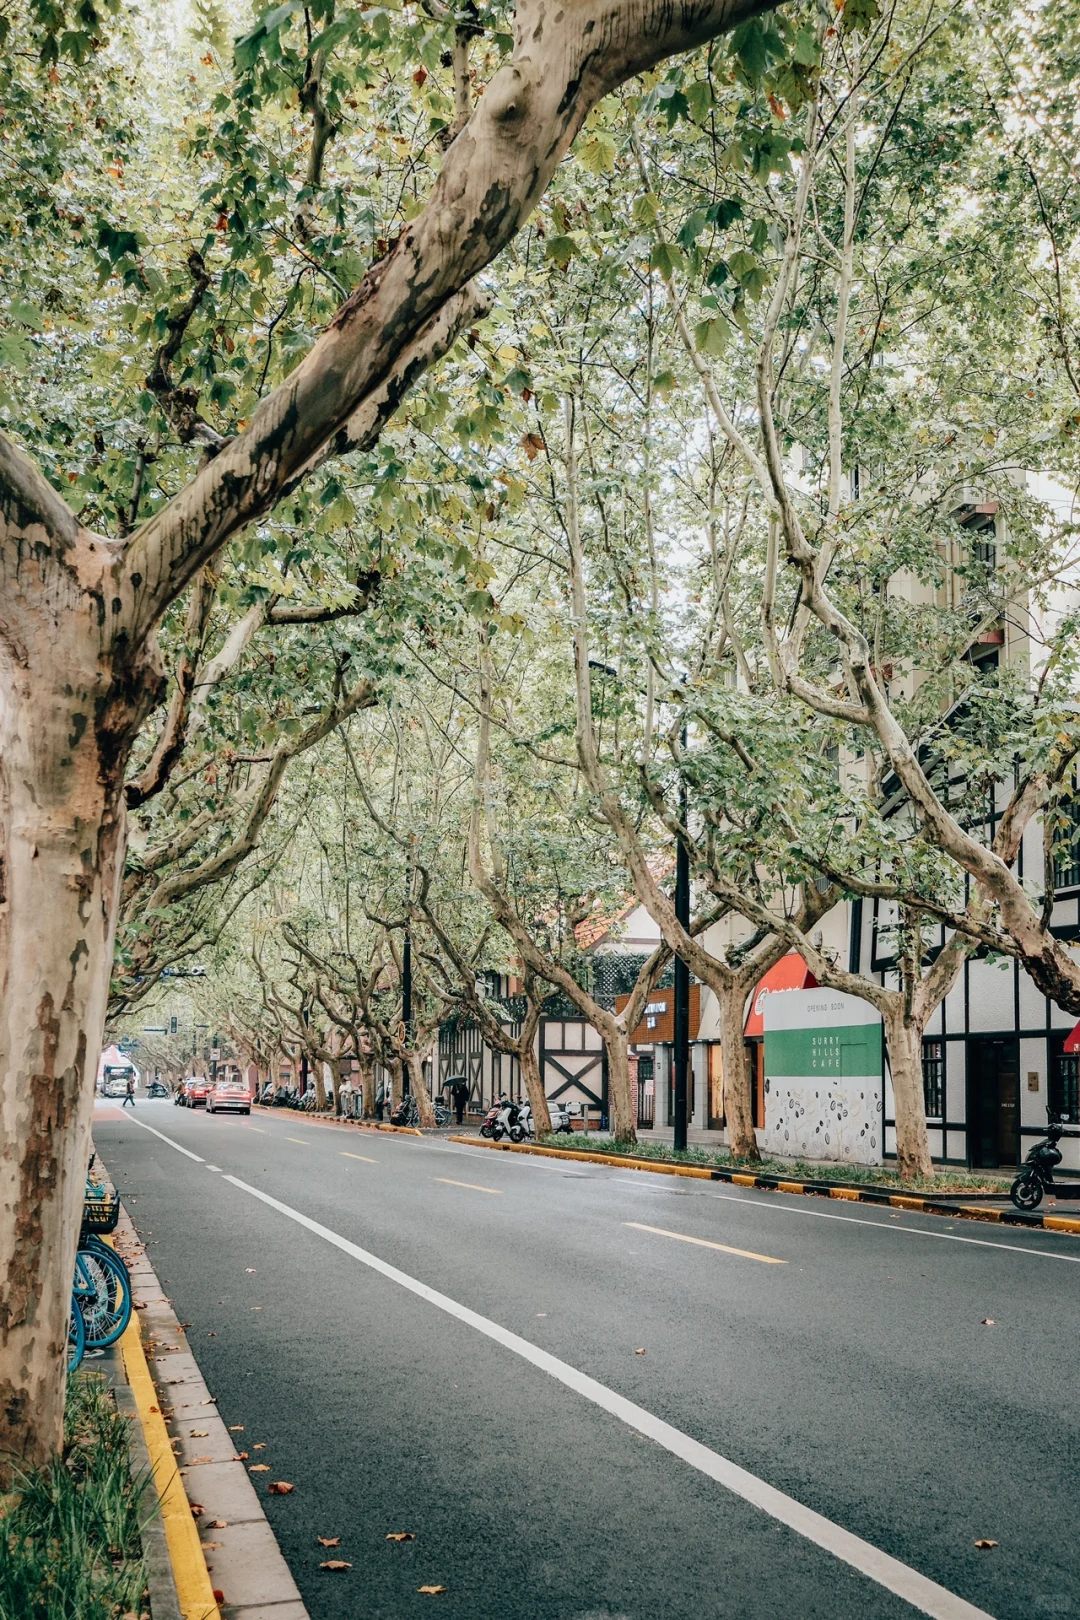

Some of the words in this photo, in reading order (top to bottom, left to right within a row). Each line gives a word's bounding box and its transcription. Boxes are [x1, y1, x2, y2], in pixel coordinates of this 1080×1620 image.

[807, 1004, 827, 1012] OPENING
[831, 1002, 844, 1011] SOON
[812, 1037, 839, 1045] SURRY
[812, 1048, 839, 1056] HILLS
[812, 1059, 840, 1068] CAFE
